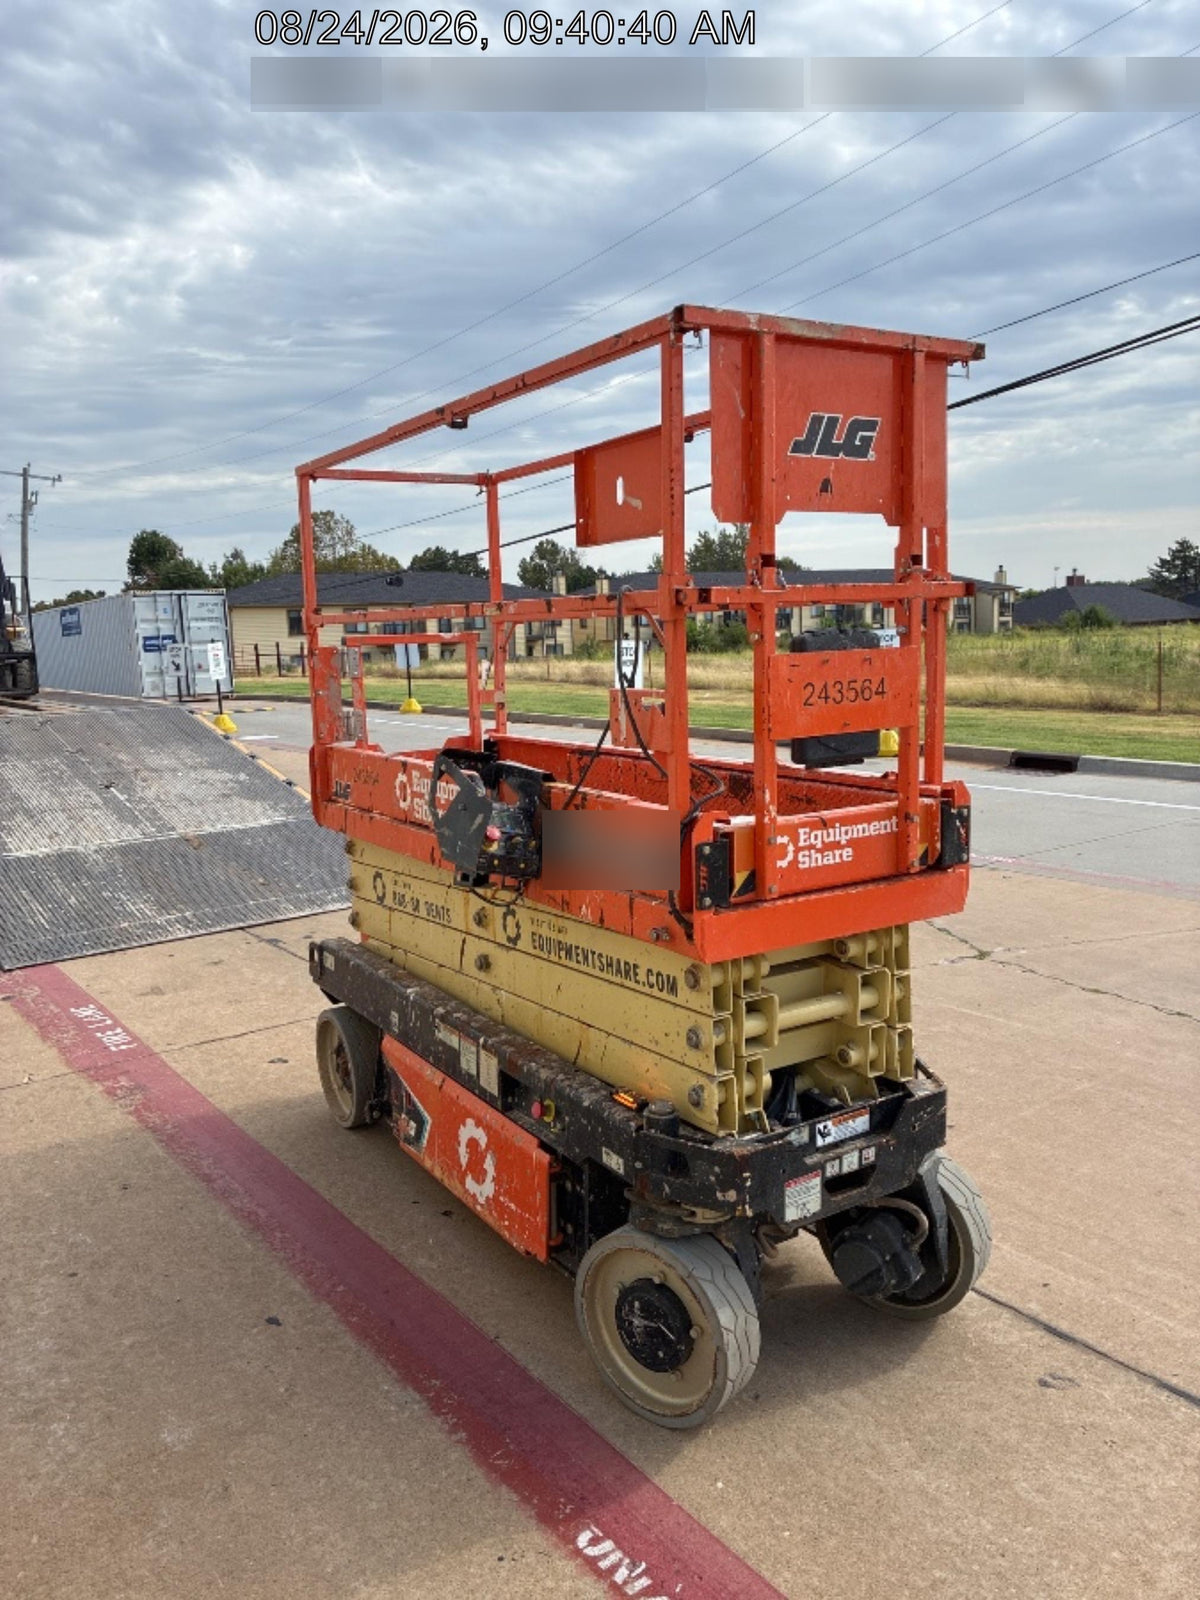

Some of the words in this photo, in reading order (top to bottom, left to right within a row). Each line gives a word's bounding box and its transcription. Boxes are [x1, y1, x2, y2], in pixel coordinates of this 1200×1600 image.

[787, 412, 881, 461] JLG
[803, 677, 887, 706] 243564
[798, 815, 899, 848] Equipment
[798, 847, 853, 869] Share
[530, 931, 678, 998] EQUIPMENTSHARE.COM
